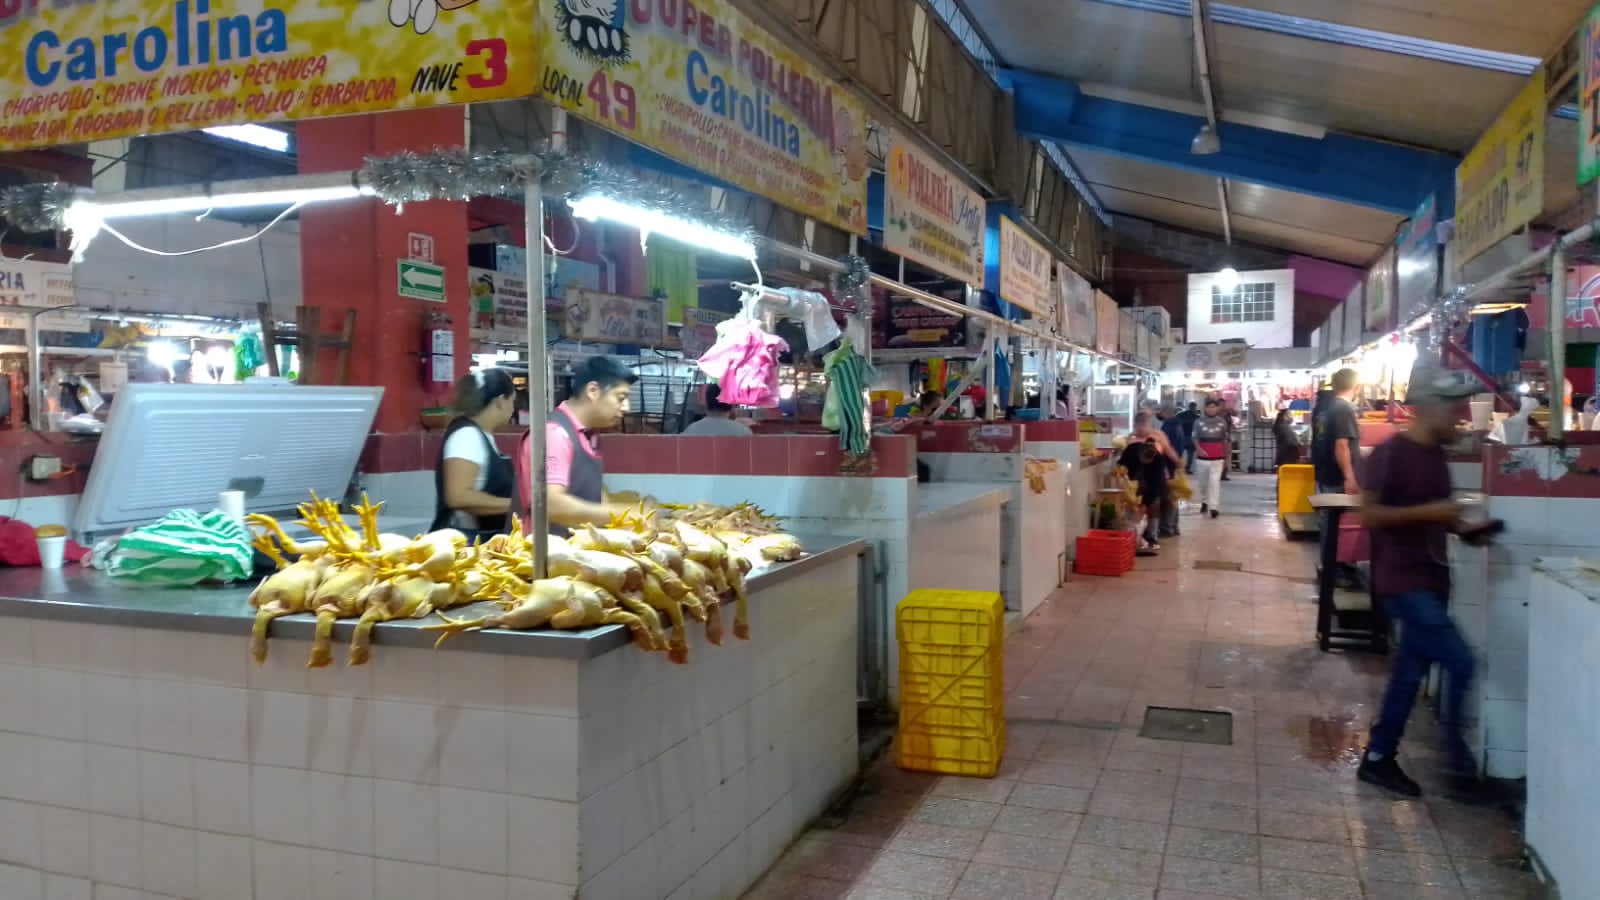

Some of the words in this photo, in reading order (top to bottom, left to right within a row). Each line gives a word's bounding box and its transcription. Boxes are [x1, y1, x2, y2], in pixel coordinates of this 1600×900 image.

[26, 0, 287, 87] Carolina
[411, 62, 463, 93] NAVE
[465, 37, 507, 89] 3
[3, 88, 93, 119] CHORIPOLLO
[103, 80, 157, 106] CARNE
[162, 69, 231, 97] MOLIDA
[242, 55, 327, 87] PECHUGA
[72, 109, 144, 134] ADOBADA
[165, 98, 236, 125] RELLENA
[243, 89, 294, 114] POLLO
[311, 77, 398, 107] BARBACOA
[543, 65, 583, 107] LOCAL
[588, 69, 636, 131] 49
[687, 50, 799, 158] Carolina
